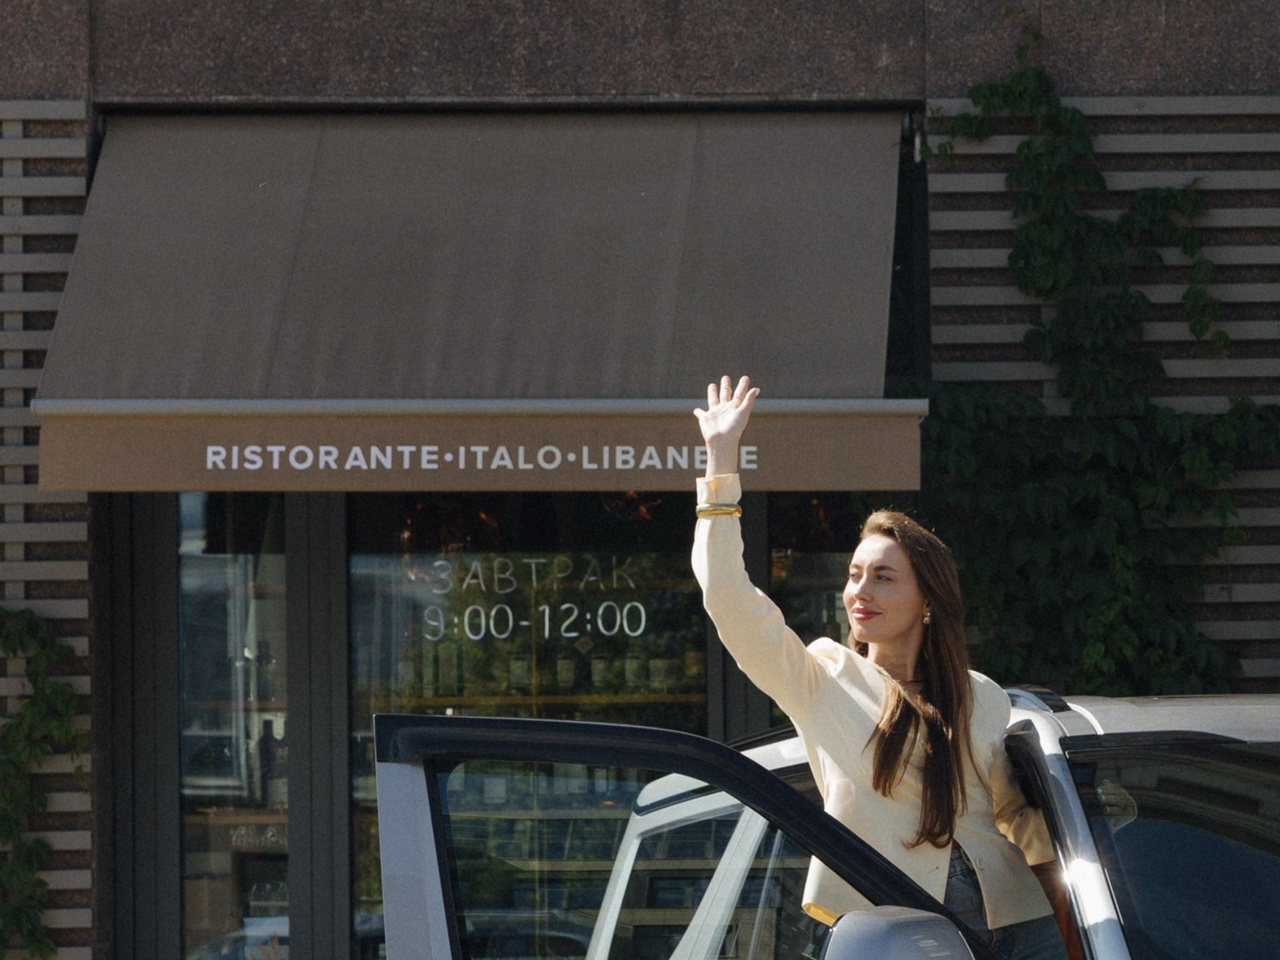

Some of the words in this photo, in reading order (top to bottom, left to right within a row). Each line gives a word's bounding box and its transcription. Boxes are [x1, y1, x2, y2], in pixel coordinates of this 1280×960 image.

[581, 444, 759, 471] LIBANEE
[431, 555, 636, 594] ЗАВТРАК
[423, 601, 647, 641] 9:00-12:00
